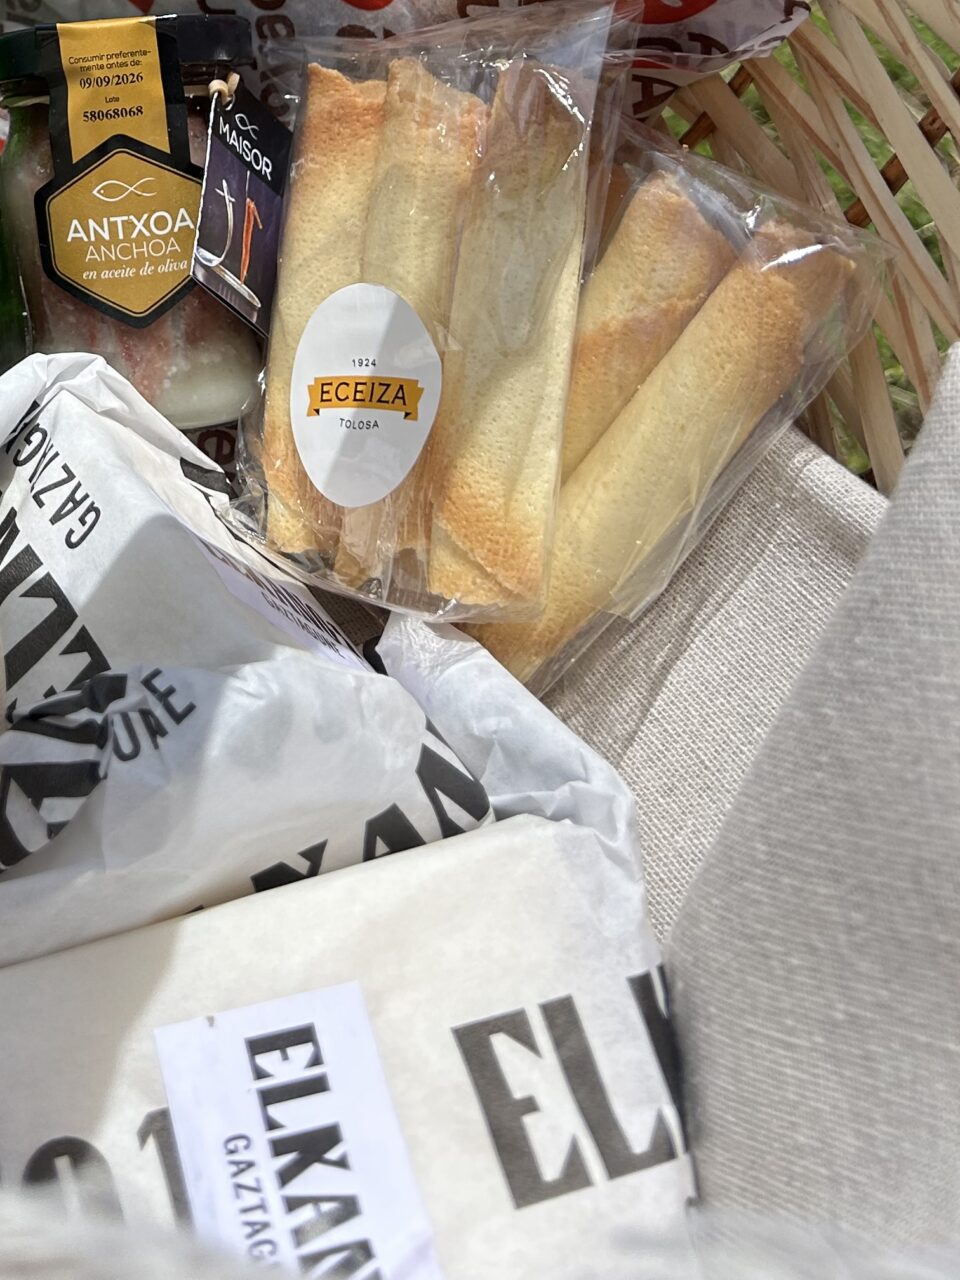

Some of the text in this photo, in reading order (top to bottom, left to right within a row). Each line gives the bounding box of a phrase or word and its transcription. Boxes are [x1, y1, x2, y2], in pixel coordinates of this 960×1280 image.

[68, 53, 106, 65] Consumir
[80, 62, 105, 73] mente
[106, 60, 129, 70] antes
[79, 71, 144, 90] 09/09/2026
[104, 96, 120, 104] Lote
[82, 105, 144, 123] 58068068
[218, 115, 274, 182] MAISOR
[66, 207, 195, 242] ANTXOA
[85, 236, 181, 263] ANCHOA
[82, 258, 188, 280] en aceite de oliva
[351, 357, 378, 368] 1924
[319, 381, 408, 407] ECEIZA
[338, 417, 380, 430] TOLOSA
